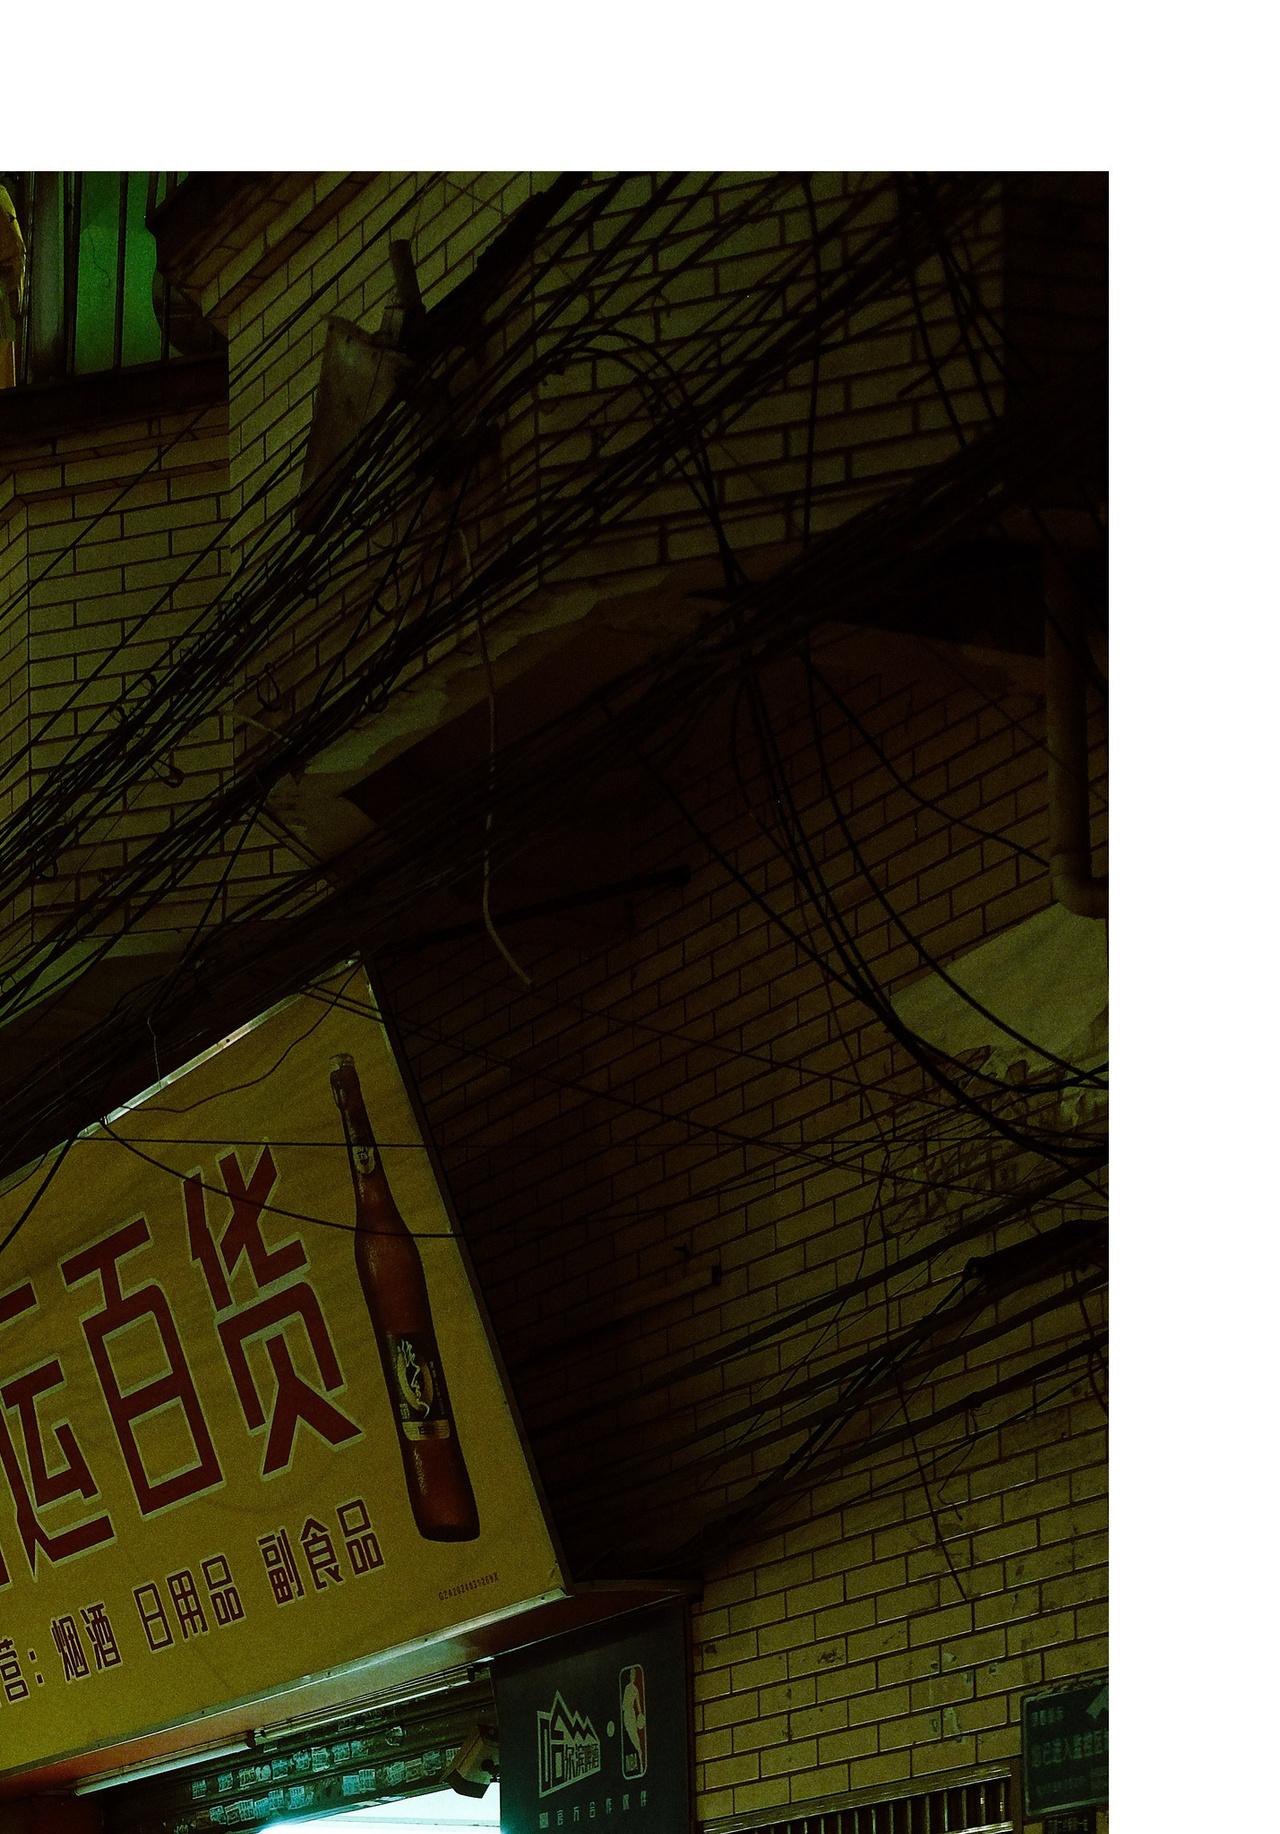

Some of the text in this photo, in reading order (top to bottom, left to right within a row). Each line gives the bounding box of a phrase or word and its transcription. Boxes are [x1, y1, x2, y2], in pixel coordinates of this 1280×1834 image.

[52, 1600, 121, 1684] 烟酒
[139, 1554, 246, 1655] 日用品
[259, 1497, 384, 1611] 副食品
